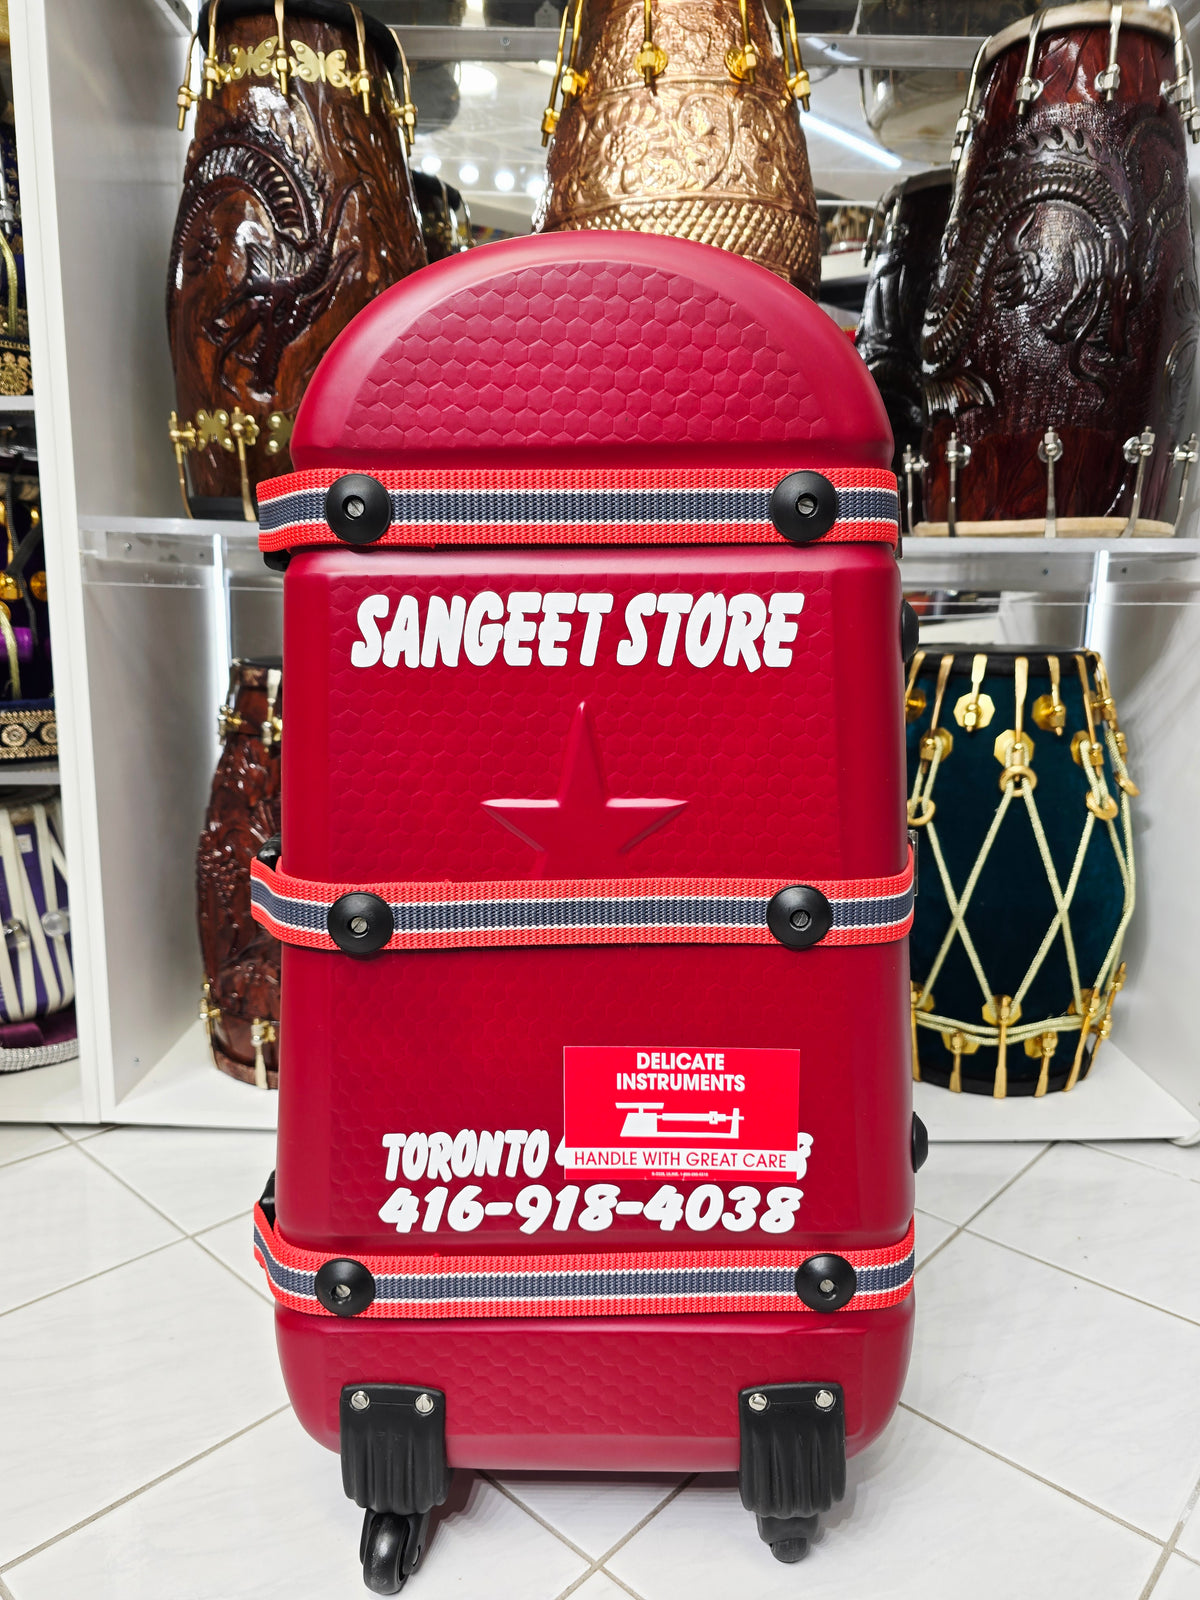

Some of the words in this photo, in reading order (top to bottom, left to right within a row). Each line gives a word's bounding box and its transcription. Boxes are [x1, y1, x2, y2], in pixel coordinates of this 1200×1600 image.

[350, 590, 614, 668] SANGEET
[616, 591, 806, 673] STORE
[636, 1052, 725, 1071] DELICATE
[616, 1073, 746, 1092] INSTRUMENTS
[381, 1128, 550, 1183] TORONTO
[574, 1151, 638, 1166] HANDLE
[642, 1152, 681, 1166] WITH
[686, 1152, 738, 1168] GREAT
[743, 1153, 787, 1169] CARE
[377, 1183, 805, 1235] 416-918-4038
